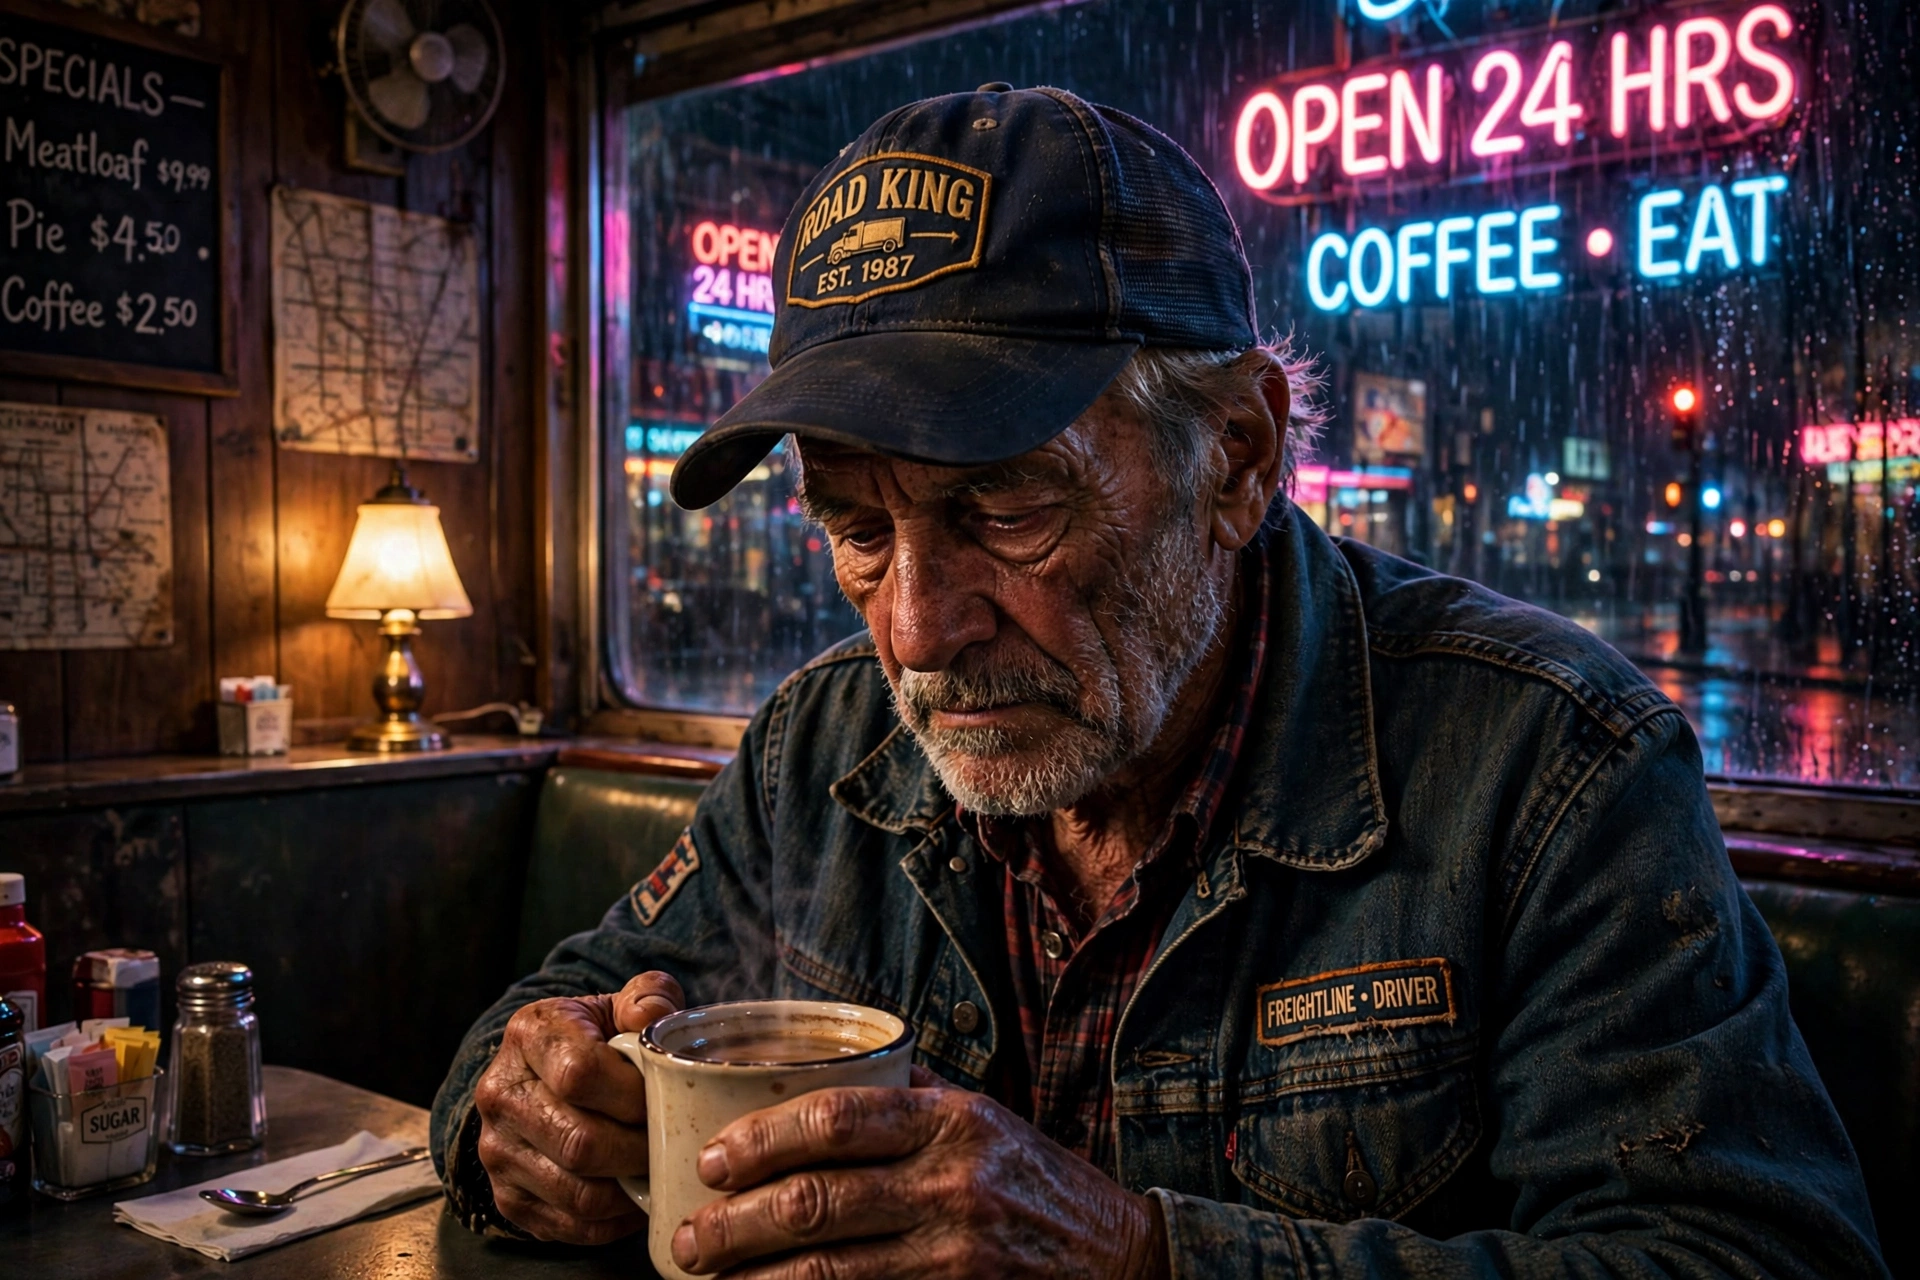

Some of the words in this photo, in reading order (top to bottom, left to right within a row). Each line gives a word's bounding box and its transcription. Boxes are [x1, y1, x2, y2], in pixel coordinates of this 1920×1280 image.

[0, 37, 164, 116] SPECIALS
[1234, 62, 1444, 191] OPEN
[1469, 40, 1584, 159] 24
[1608, 4, 1795, 139] HRS
[5, 116, 149, 191] Meatloaf
[6, 198, 66, 253] Pie
[90, 213, 181, 263] $4.50
[798, 174, 868, 256] ROAD
[876, 168, 974, 221] KING
[1307, 205, 1561, 311] COFFEE
[1636, 175, 1788, 279] EAT
[692, 220, 780, 273] OPEN
[817, 265, 853, 295] EST.
[861, 254, 914, 283] 1987
[1, 275, 105, 332] Coffee
[116, 290, 198, 335] $2.50
[693, 264, 734, 306] 24
[1267, 984, 1356, 1028] FREIGHTLINE
[1372, 976, 1439, 1010] DRIVER
[90, 1106, 140, 1134] SUGAR
